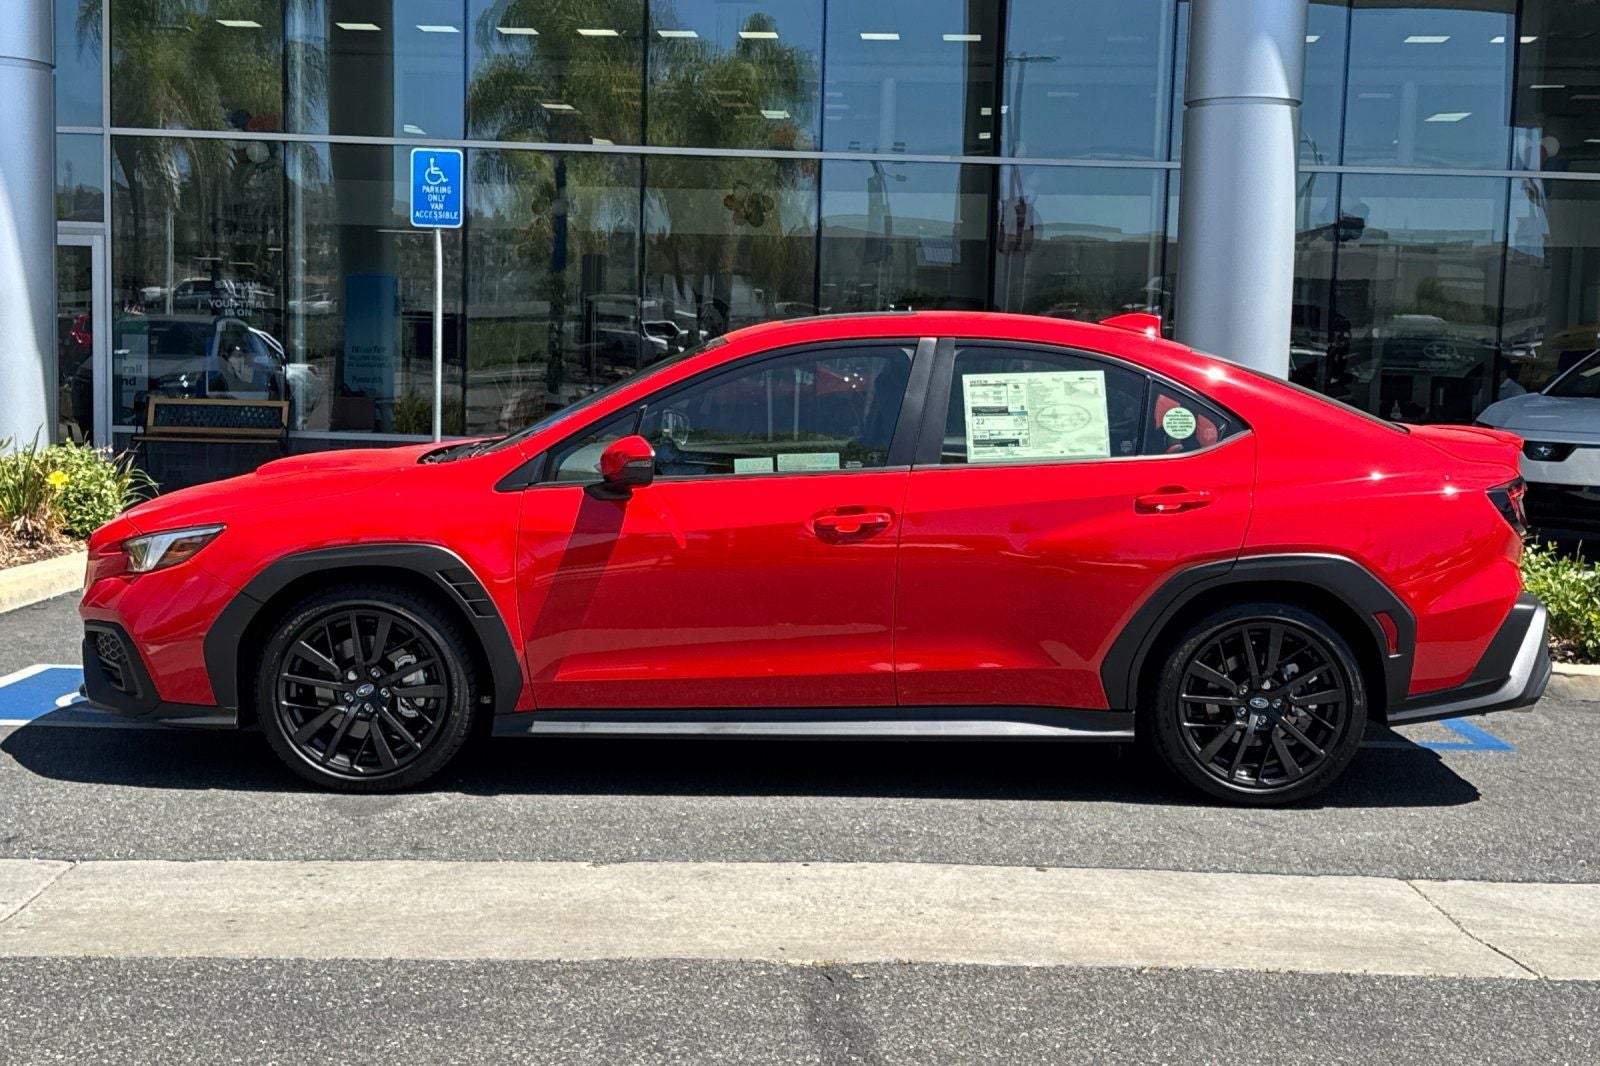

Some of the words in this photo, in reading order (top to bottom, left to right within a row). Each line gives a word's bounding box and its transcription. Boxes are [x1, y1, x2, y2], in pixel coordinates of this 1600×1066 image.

[422, 185, 452, 194] PARKING
[427, 194, 446, 202] ONLY
[415, 210, 458, 219] ACCESSIBLE
[225, 308, 235, 316] IS
[237, 308, 252, 316] ON
